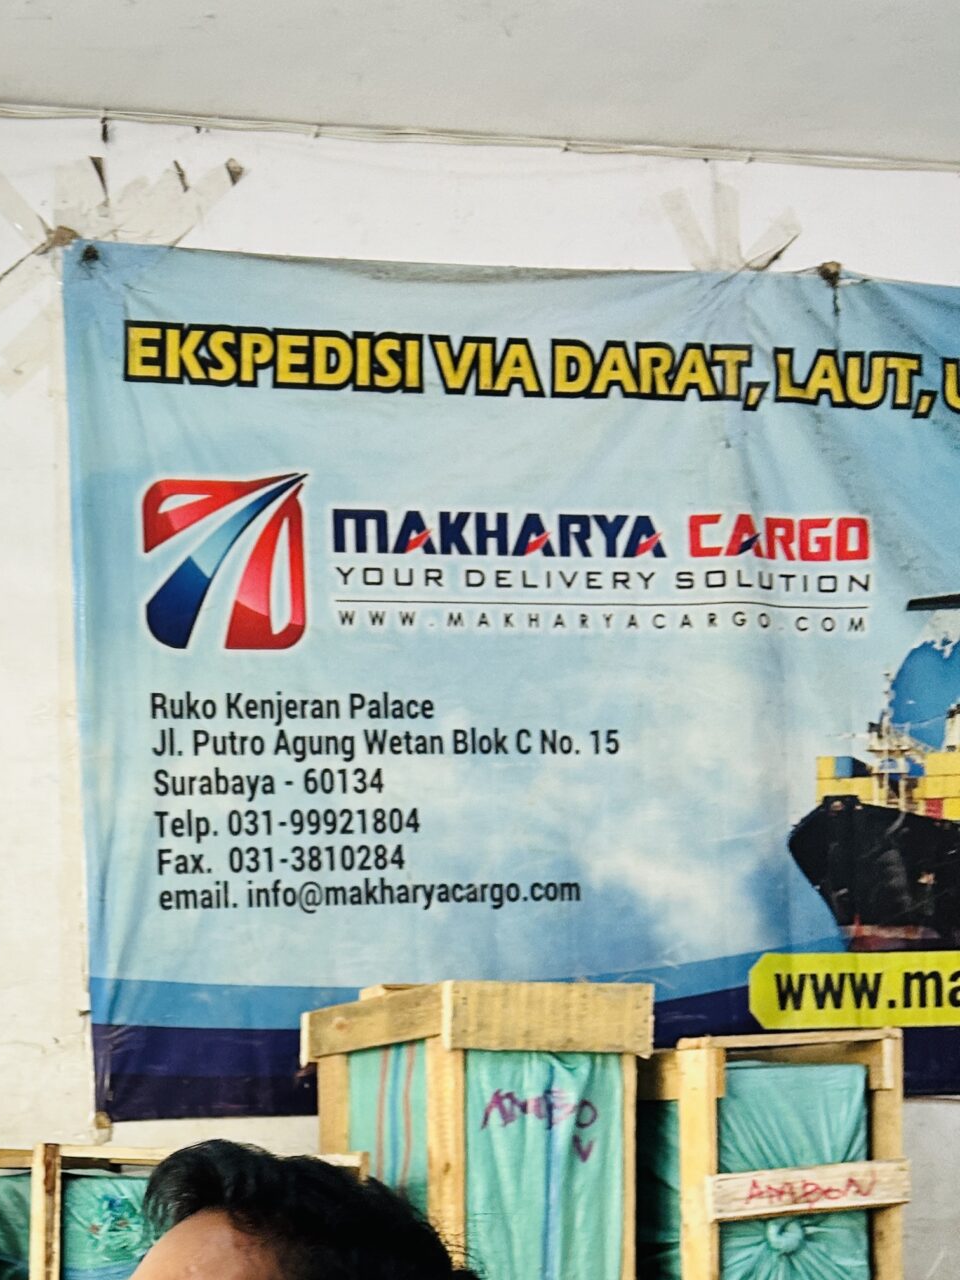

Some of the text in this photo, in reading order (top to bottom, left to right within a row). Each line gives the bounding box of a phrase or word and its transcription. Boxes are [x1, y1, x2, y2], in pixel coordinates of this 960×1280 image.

[123, 319, 424, 393] EKSPEDISI
[429, 335, 548, 397] VIA
[549, 339, 767, 411] DARAT,
[774, 346, 938, 418] LAUT,
[688, 513, 871, 562] CARGO
[334, 565, 872, 594] YOUR DELIVERY SOLUTION
[338, 608, 868, 634] WWW.MAKHARYACARGO.COM
[149, 692, 435, 725] Ruko Kenjeran Palace
[152, 728, 621, 763] Jl. Putro Agung Wetan Blok C No. 15
[153, 768, 276, 800] Surabaya
[302, 767, 385, 796] 60134
[154, 808, 421, 844] Telp. 031-99921804
[157, 843, 407, 877] Fax. 031-3810284
[158, 874, 582, 913] email. info@makharyacargo.com
